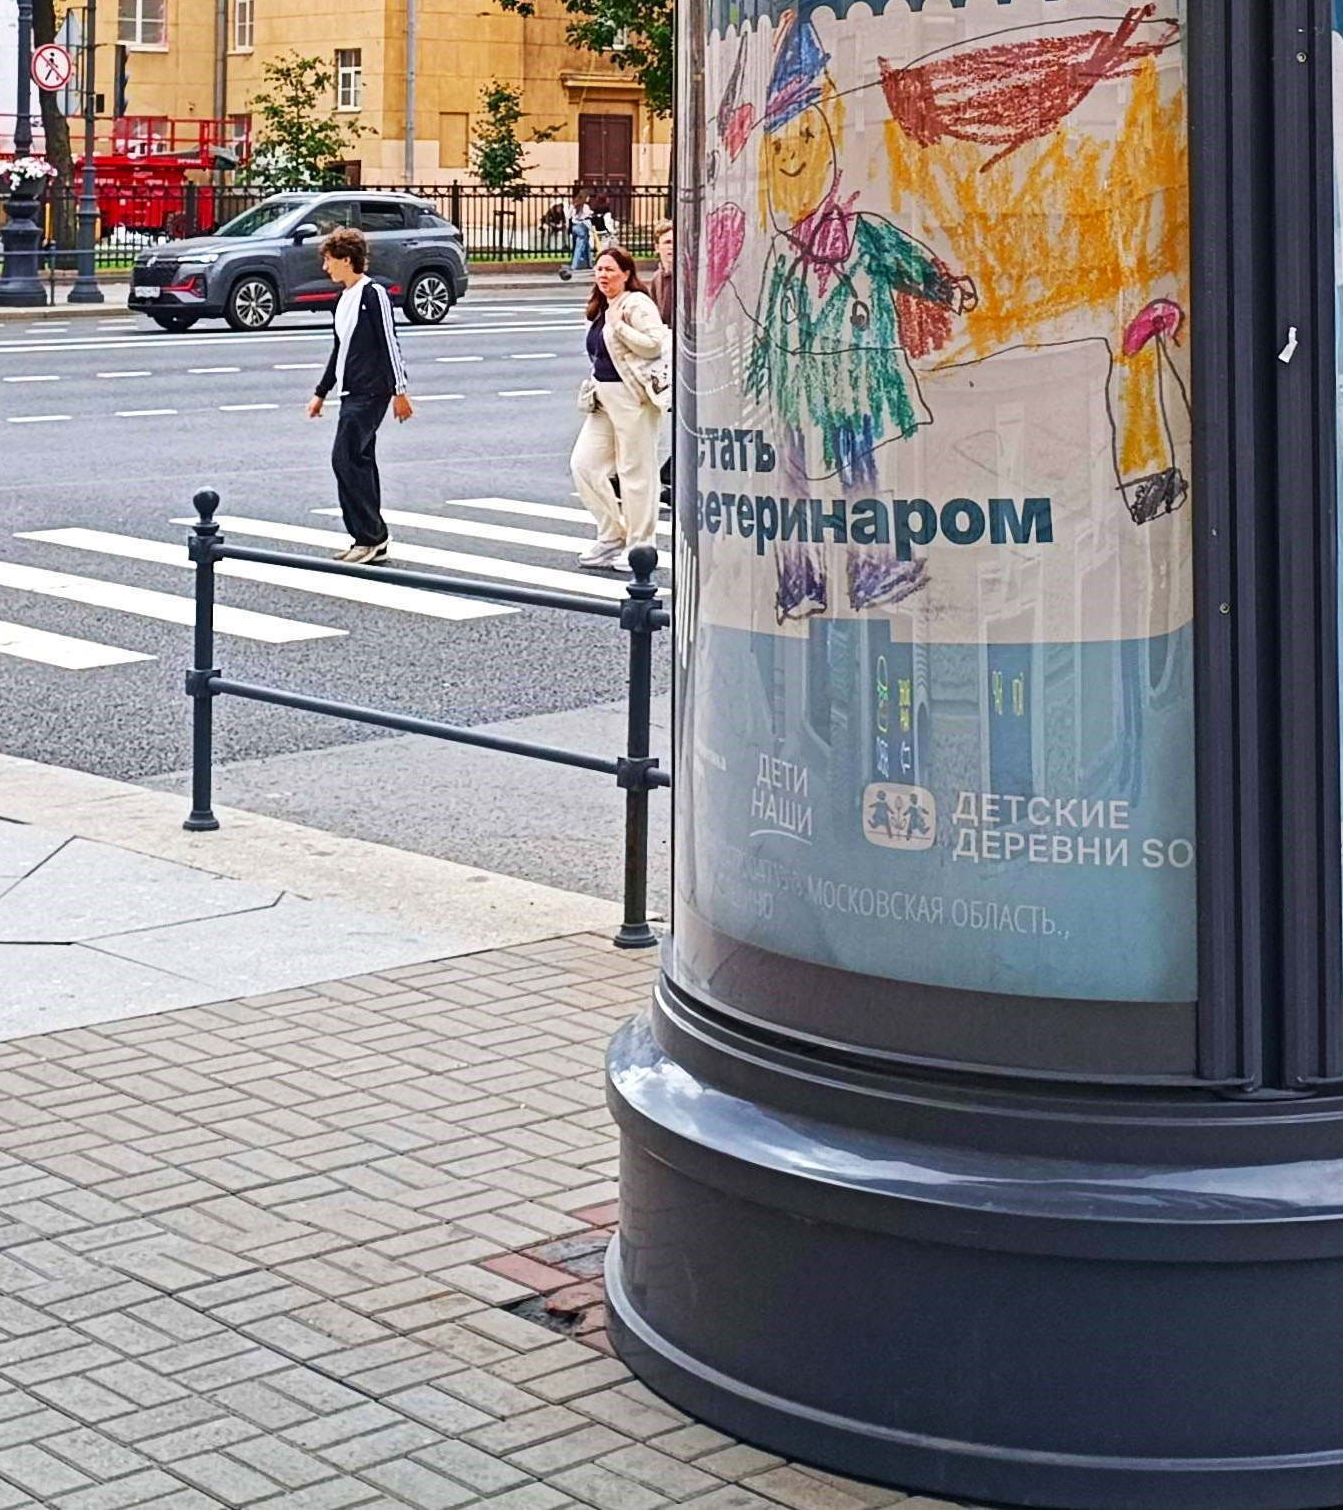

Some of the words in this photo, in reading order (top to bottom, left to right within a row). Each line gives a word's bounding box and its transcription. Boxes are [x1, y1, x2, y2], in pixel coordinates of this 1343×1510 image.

[756, 752, 809, 797] ДЕТИ
[750, 787, 813, 837] НАШИ
[952, 791, 1131, 830] ДЕТСКИЕ
[952, 827, 1129, 868] ДЕРЕВНИ
